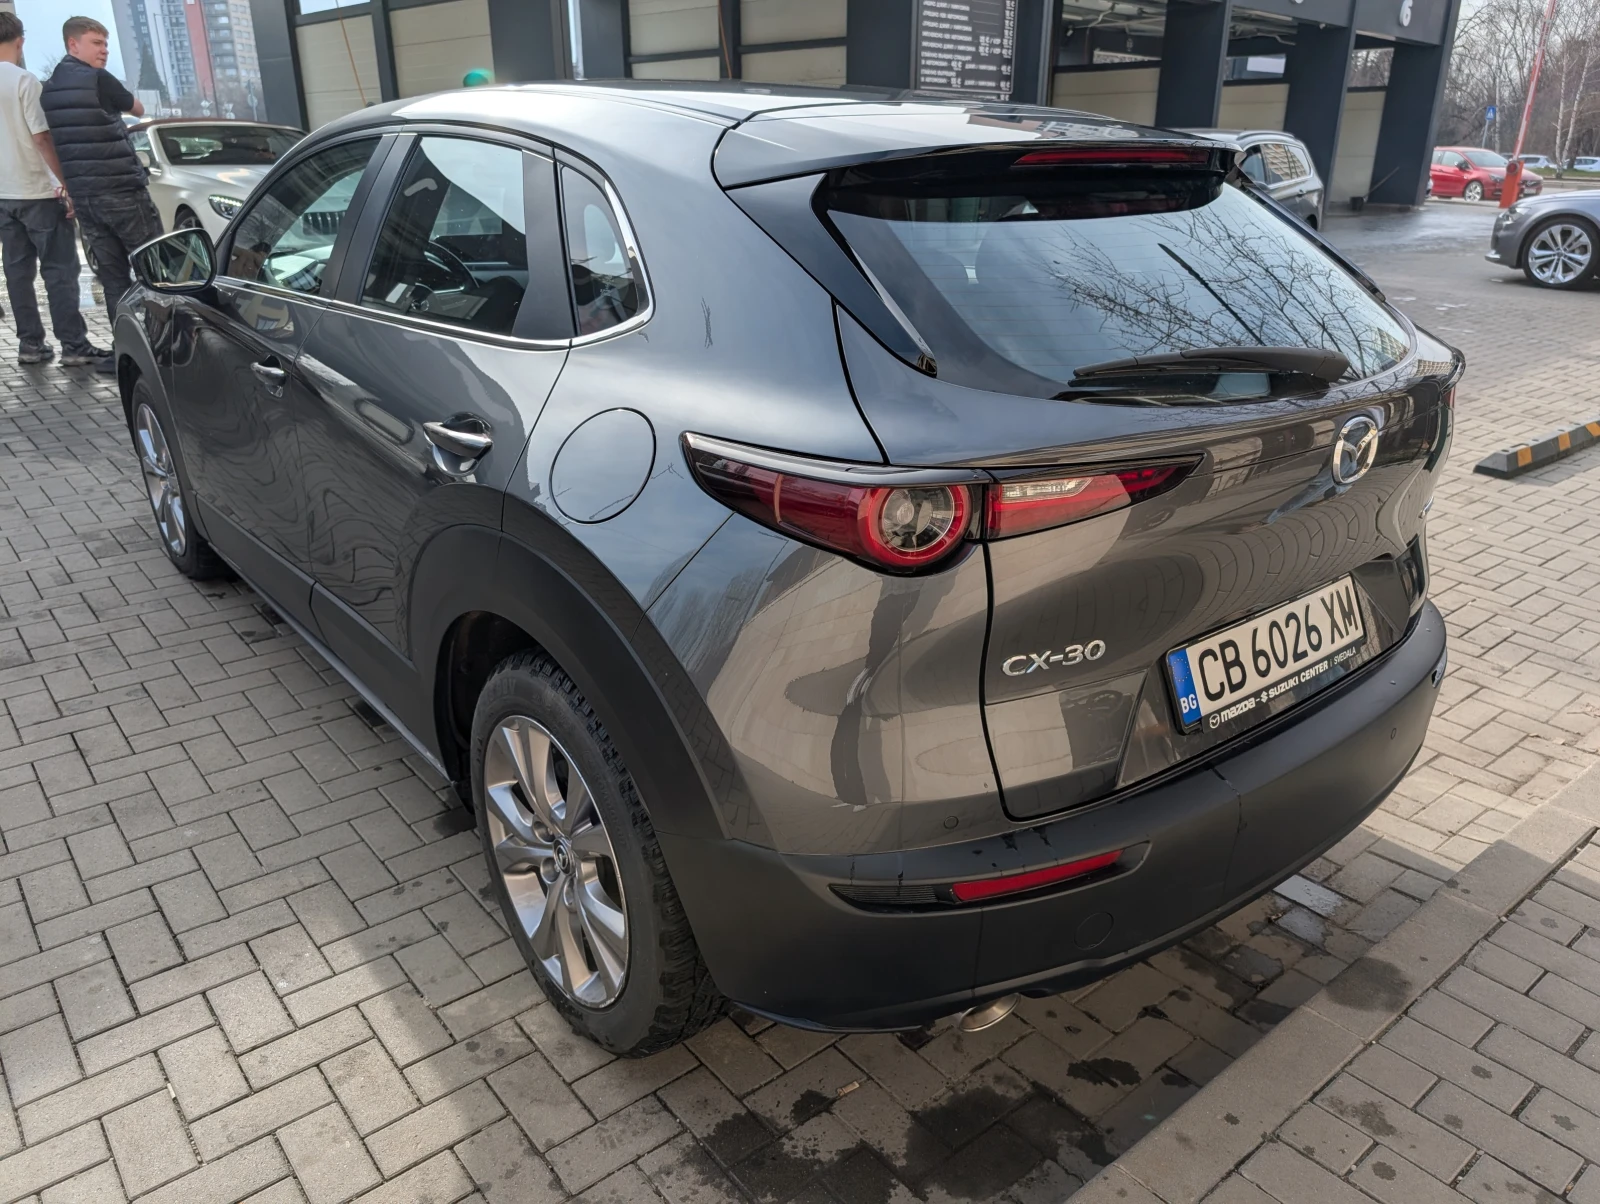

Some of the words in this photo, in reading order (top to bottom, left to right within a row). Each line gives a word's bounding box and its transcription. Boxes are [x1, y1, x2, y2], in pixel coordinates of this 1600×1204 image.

[1400, 0, 1413, 27] 6
[1002, 639, 1106, 676] CX-30
[1198, 639, 1247, 701] CB
[1252, 603, 1322, 679] 6026
[1320, 585, 1359, 645] XM
[1268, 676, 1299, 698] SUZUKI
[1300, 661, 1329, 682] CENTER
[1180, 693, 1197, 714] BG
